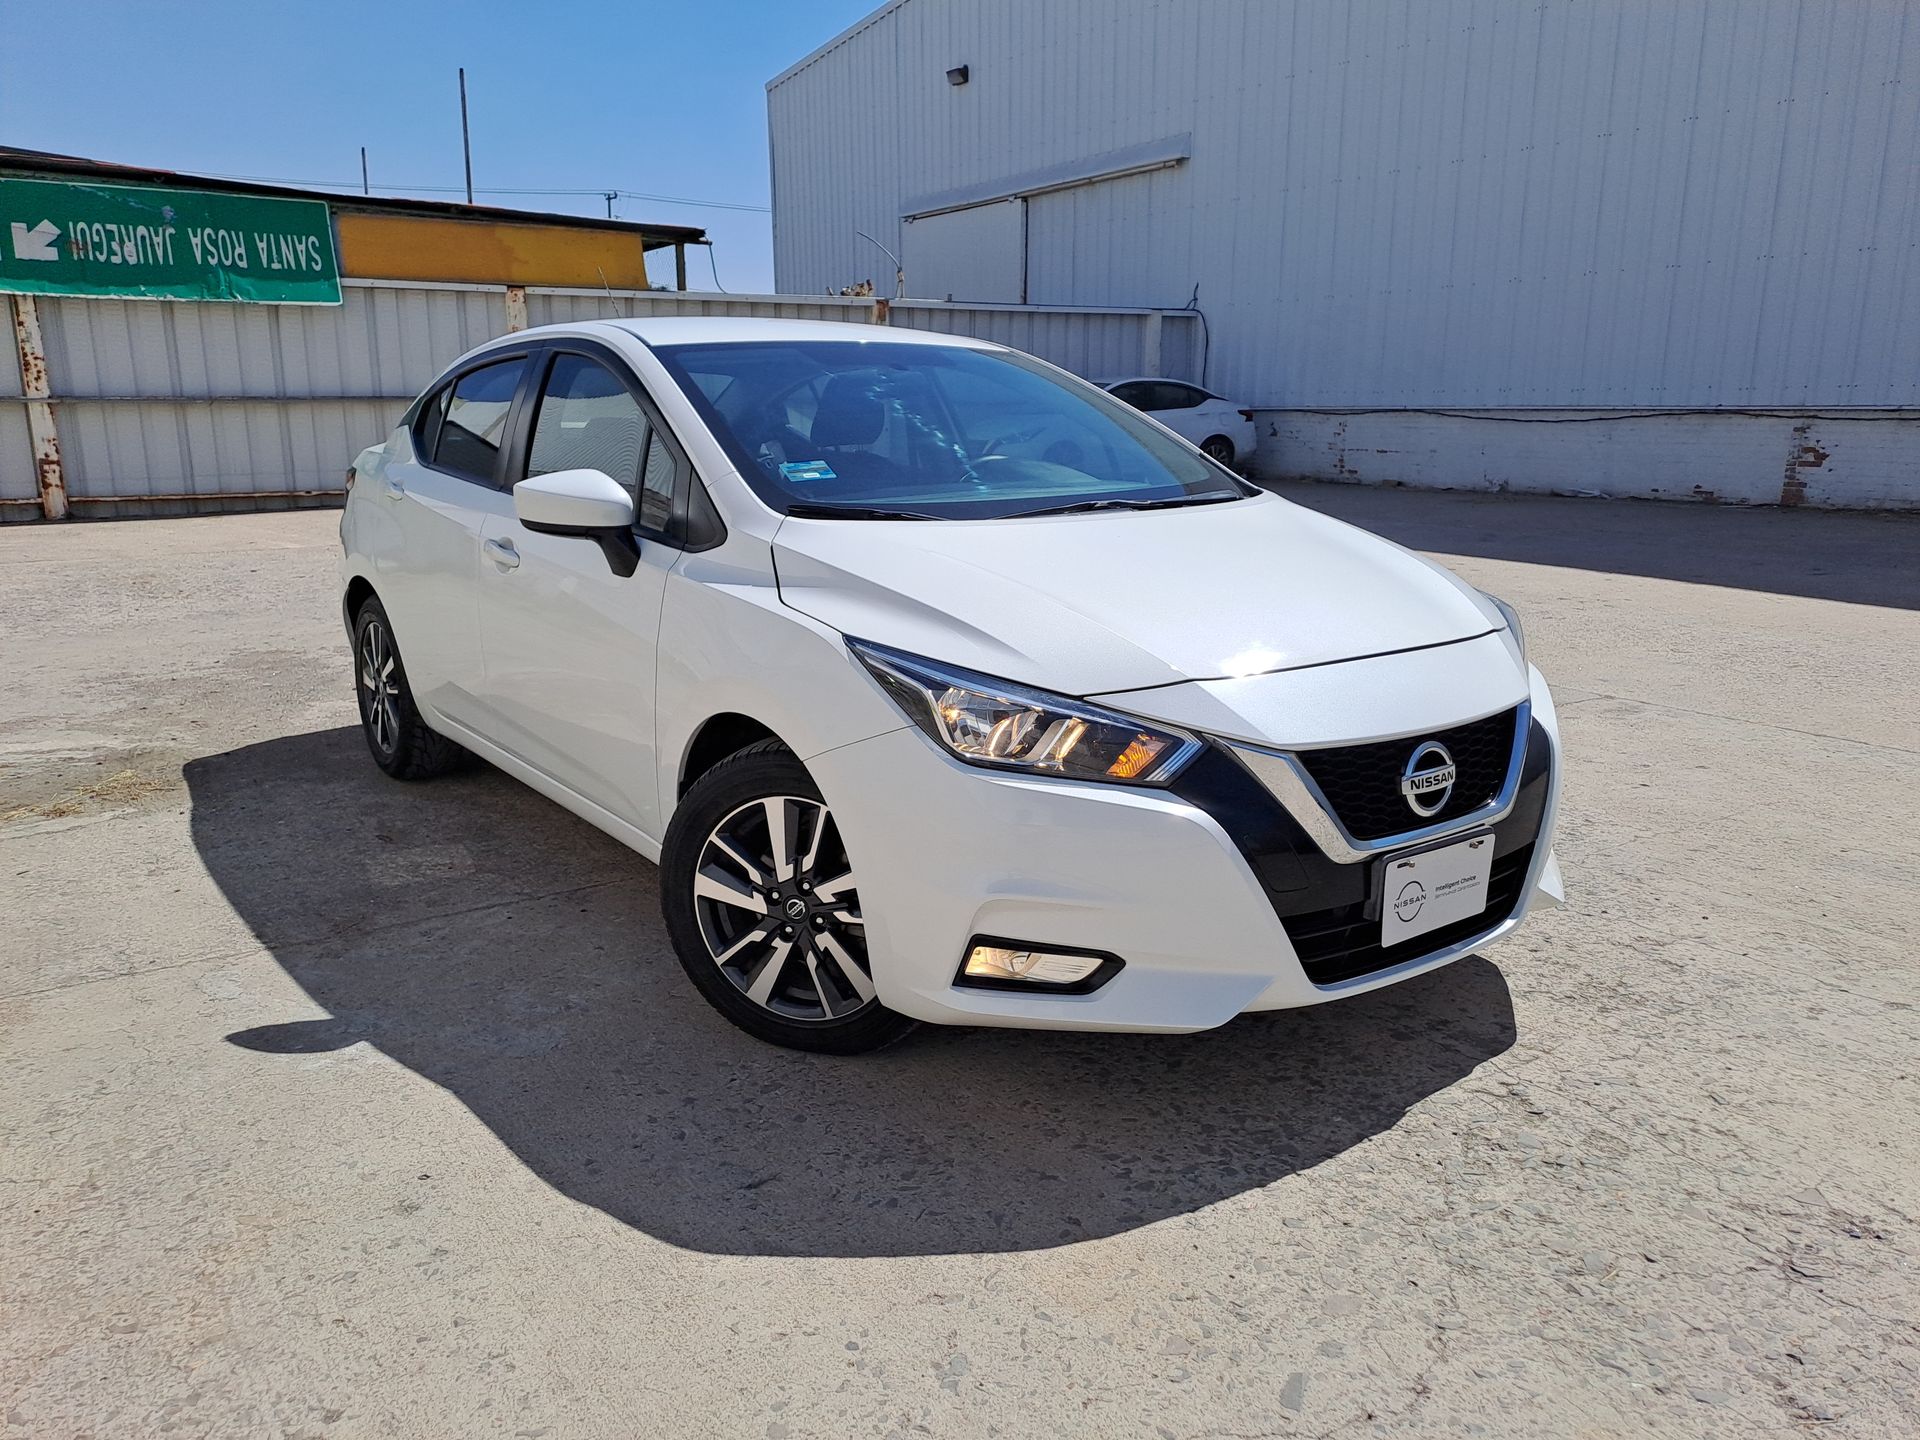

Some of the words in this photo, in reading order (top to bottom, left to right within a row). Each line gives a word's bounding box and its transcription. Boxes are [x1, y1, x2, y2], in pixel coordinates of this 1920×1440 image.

[68, 221, 176, 265] JAUREGUI
[187, 227, 248, 269] ROSA
[254, 232, 322, 272] SANTA
[1410, 769, 1455, 791] NISSAN
[1393, 893, 1427, 910] NISSAN
